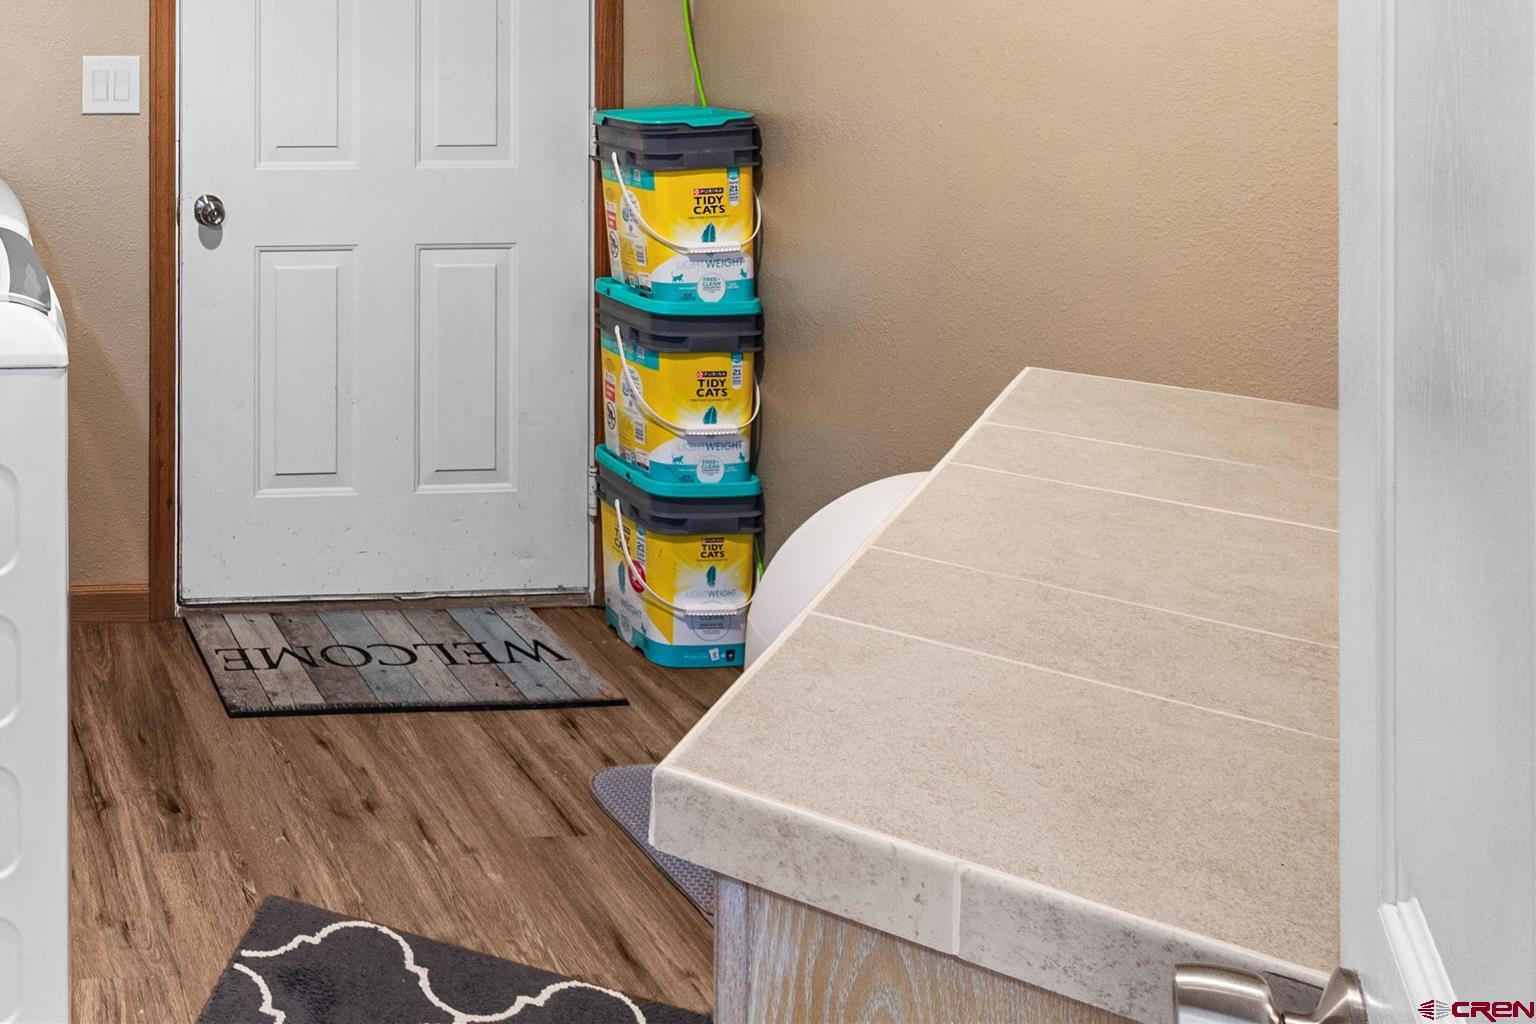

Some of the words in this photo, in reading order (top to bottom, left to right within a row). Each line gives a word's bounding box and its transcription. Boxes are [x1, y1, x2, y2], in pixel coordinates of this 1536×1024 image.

[693, 195, 724, 206] TIDY
[693, 205, 725, 215] CATS
[697, 378, 727, 388] TIDY
[696, 388, 728, 397] CATS
[701, 543, 724, 552] TIDY
[700, 551, 725, 559] CATS
[215, 638, 570, 672] WELCOME
